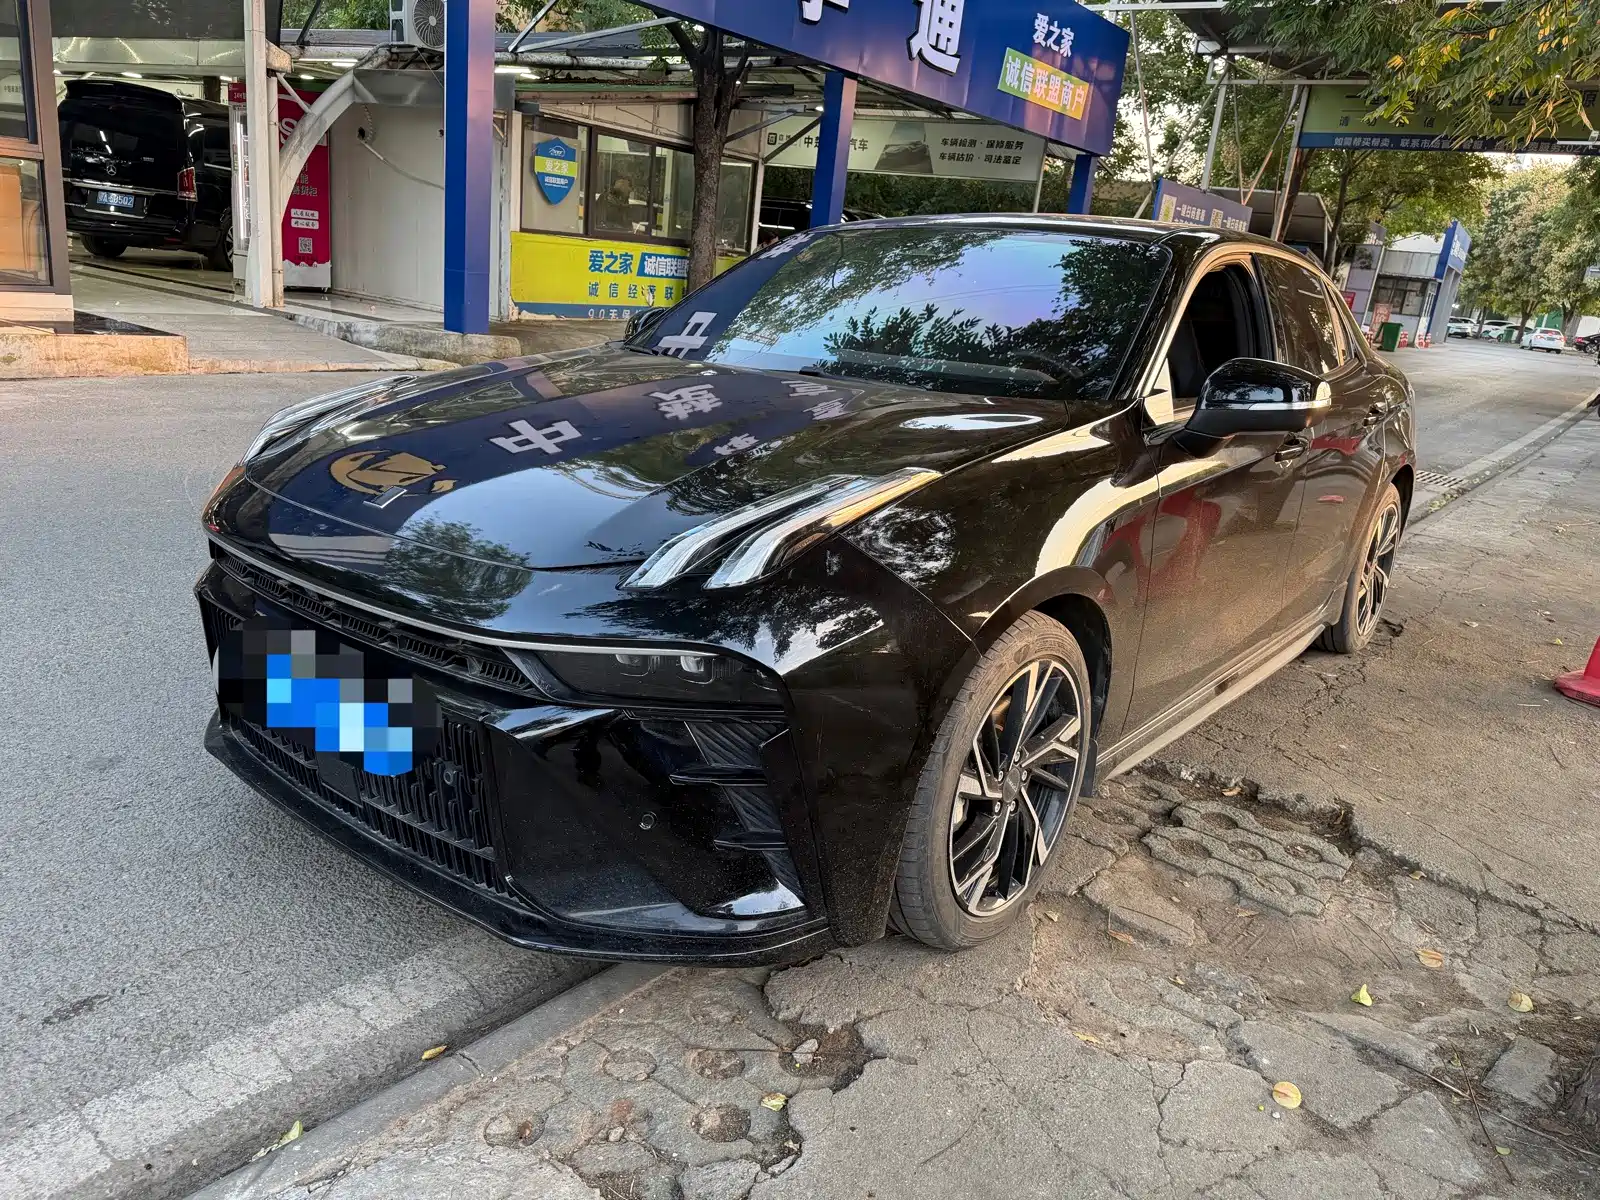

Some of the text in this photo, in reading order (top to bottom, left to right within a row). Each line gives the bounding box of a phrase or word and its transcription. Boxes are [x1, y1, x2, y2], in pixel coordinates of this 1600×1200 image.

[1033, 13, 1074, 57] 爱之家
[1005, 56, 1084, 111] 诚信联盟商户
[545, 159, 569, 174] 爱之家
[588, 250, 633, 275] 爱之家
